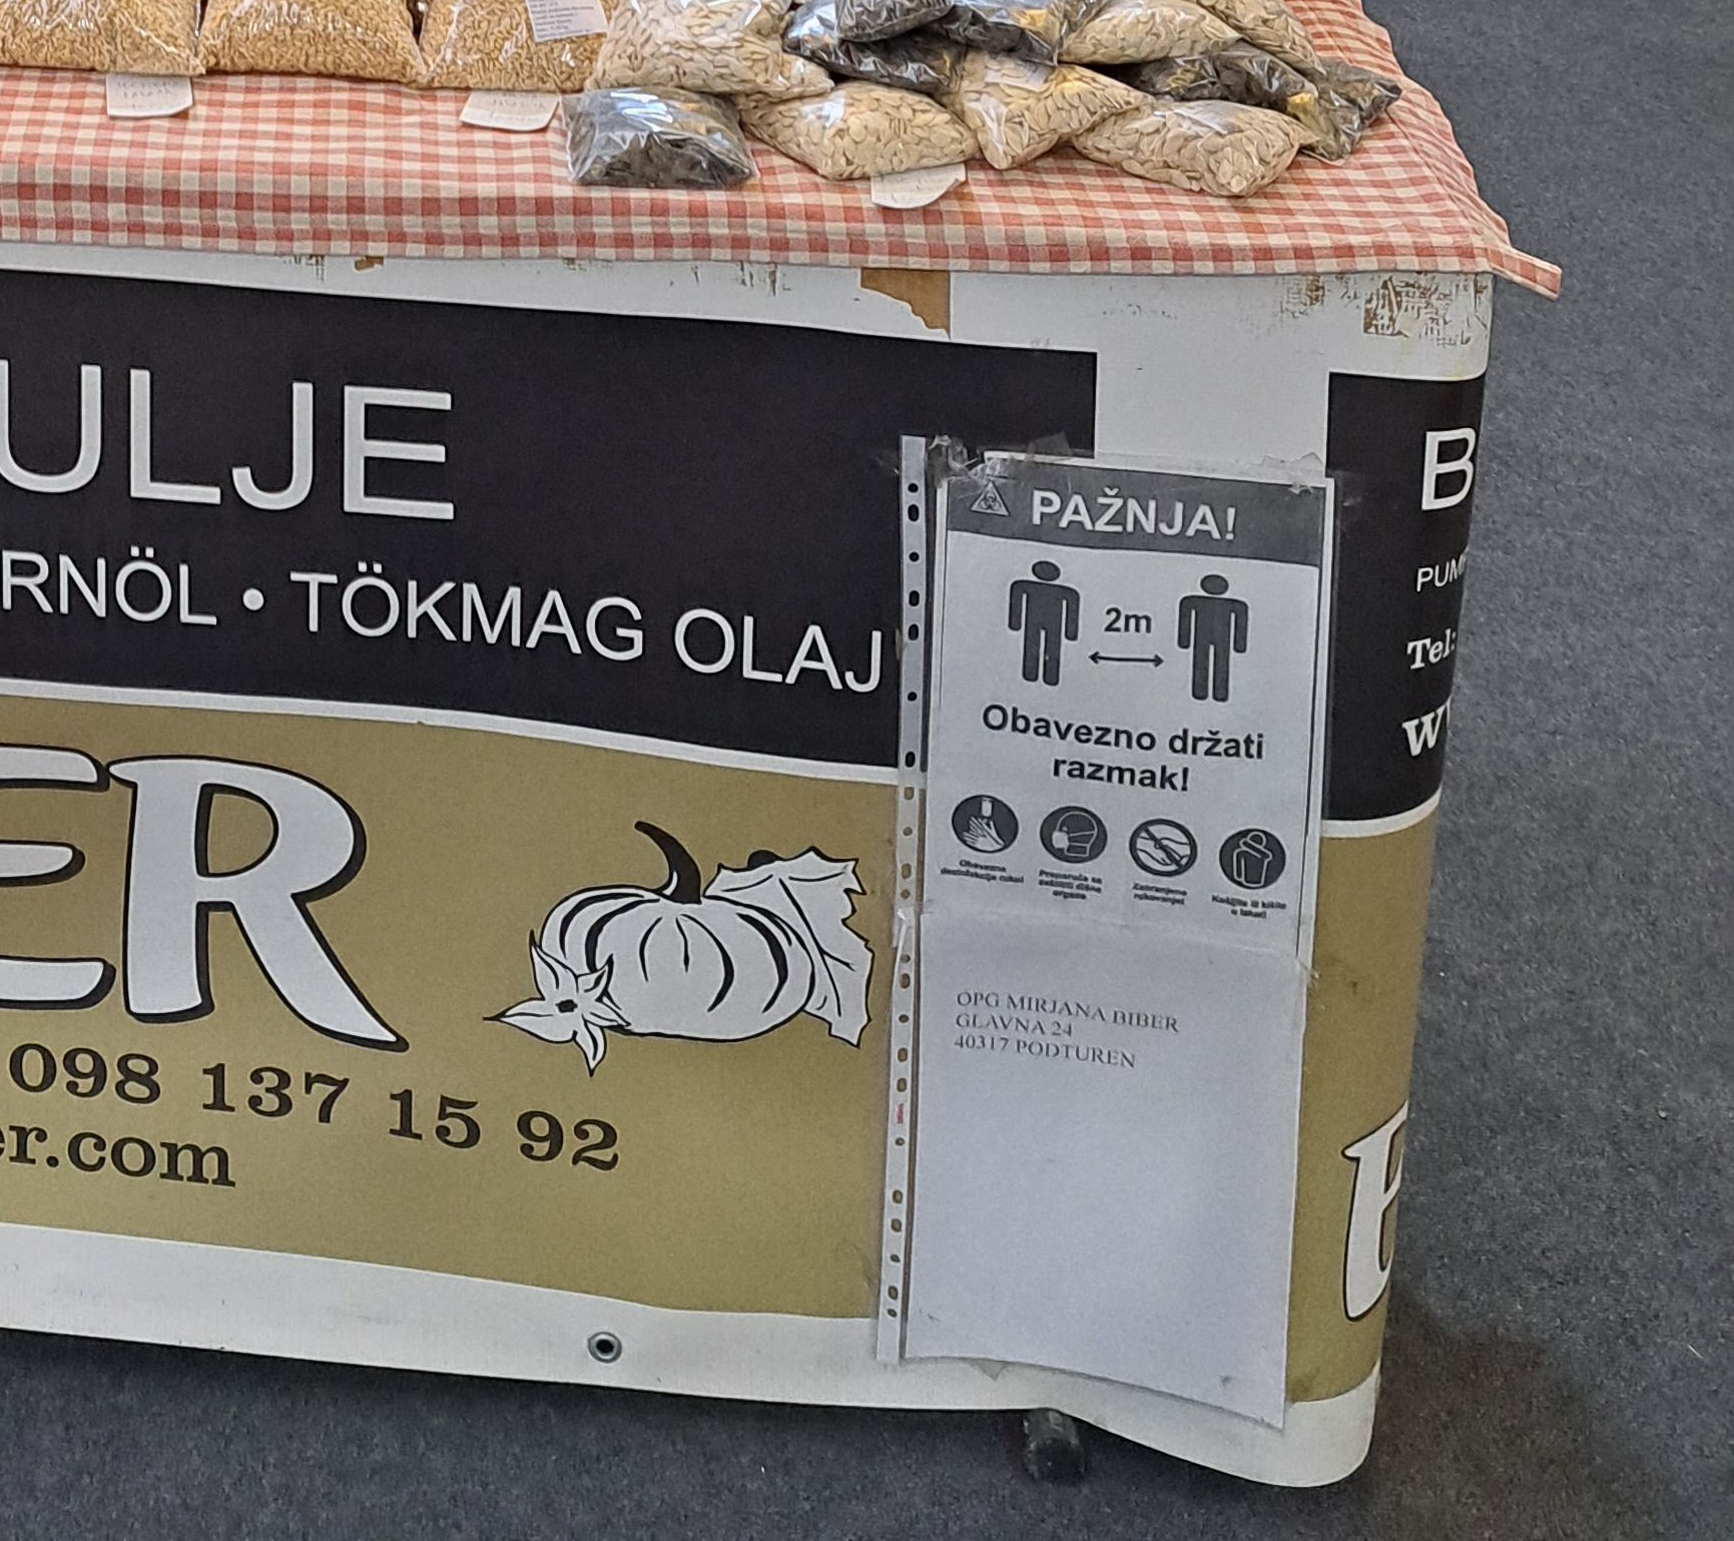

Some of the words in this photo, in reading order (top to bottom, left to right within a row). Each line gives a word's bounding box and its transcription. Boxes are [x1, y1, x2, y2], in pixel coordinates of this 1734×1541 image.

[1421, 427, 1477, 511] B
[1030, 487, 1237, 540] PAŽNJA!
[291, 562, 644, 661] TÖKMAG
[674, 609, 882, 692] OLAJ
[1103, 607, 1153, 634] 2m
[982, 703, 1157, 752] Obavezno
[1168, 728, 1265, 760] držati
[1052, 757, 1190, 792] razmak!
[955, 1012, 1046, 1036] GLAVNA
[1051, 1021, 1073, 1038] 24
[957, 991, 1000, 1008] OPG
[1006, 994, 1106, 1022] MIRJANA
[1112, 1009, 1179, 1033] BIBER
[954, 1034, 1010, 1051] 40317
[1016, 1039, 1136, 1069] PODTUREN
[10, 1042, 163, 1105] 098
[202, 1062, 351, 1124] 137
[388, 1089, 483, 1150] 15
[517, 1109, 621, 1172] 92
